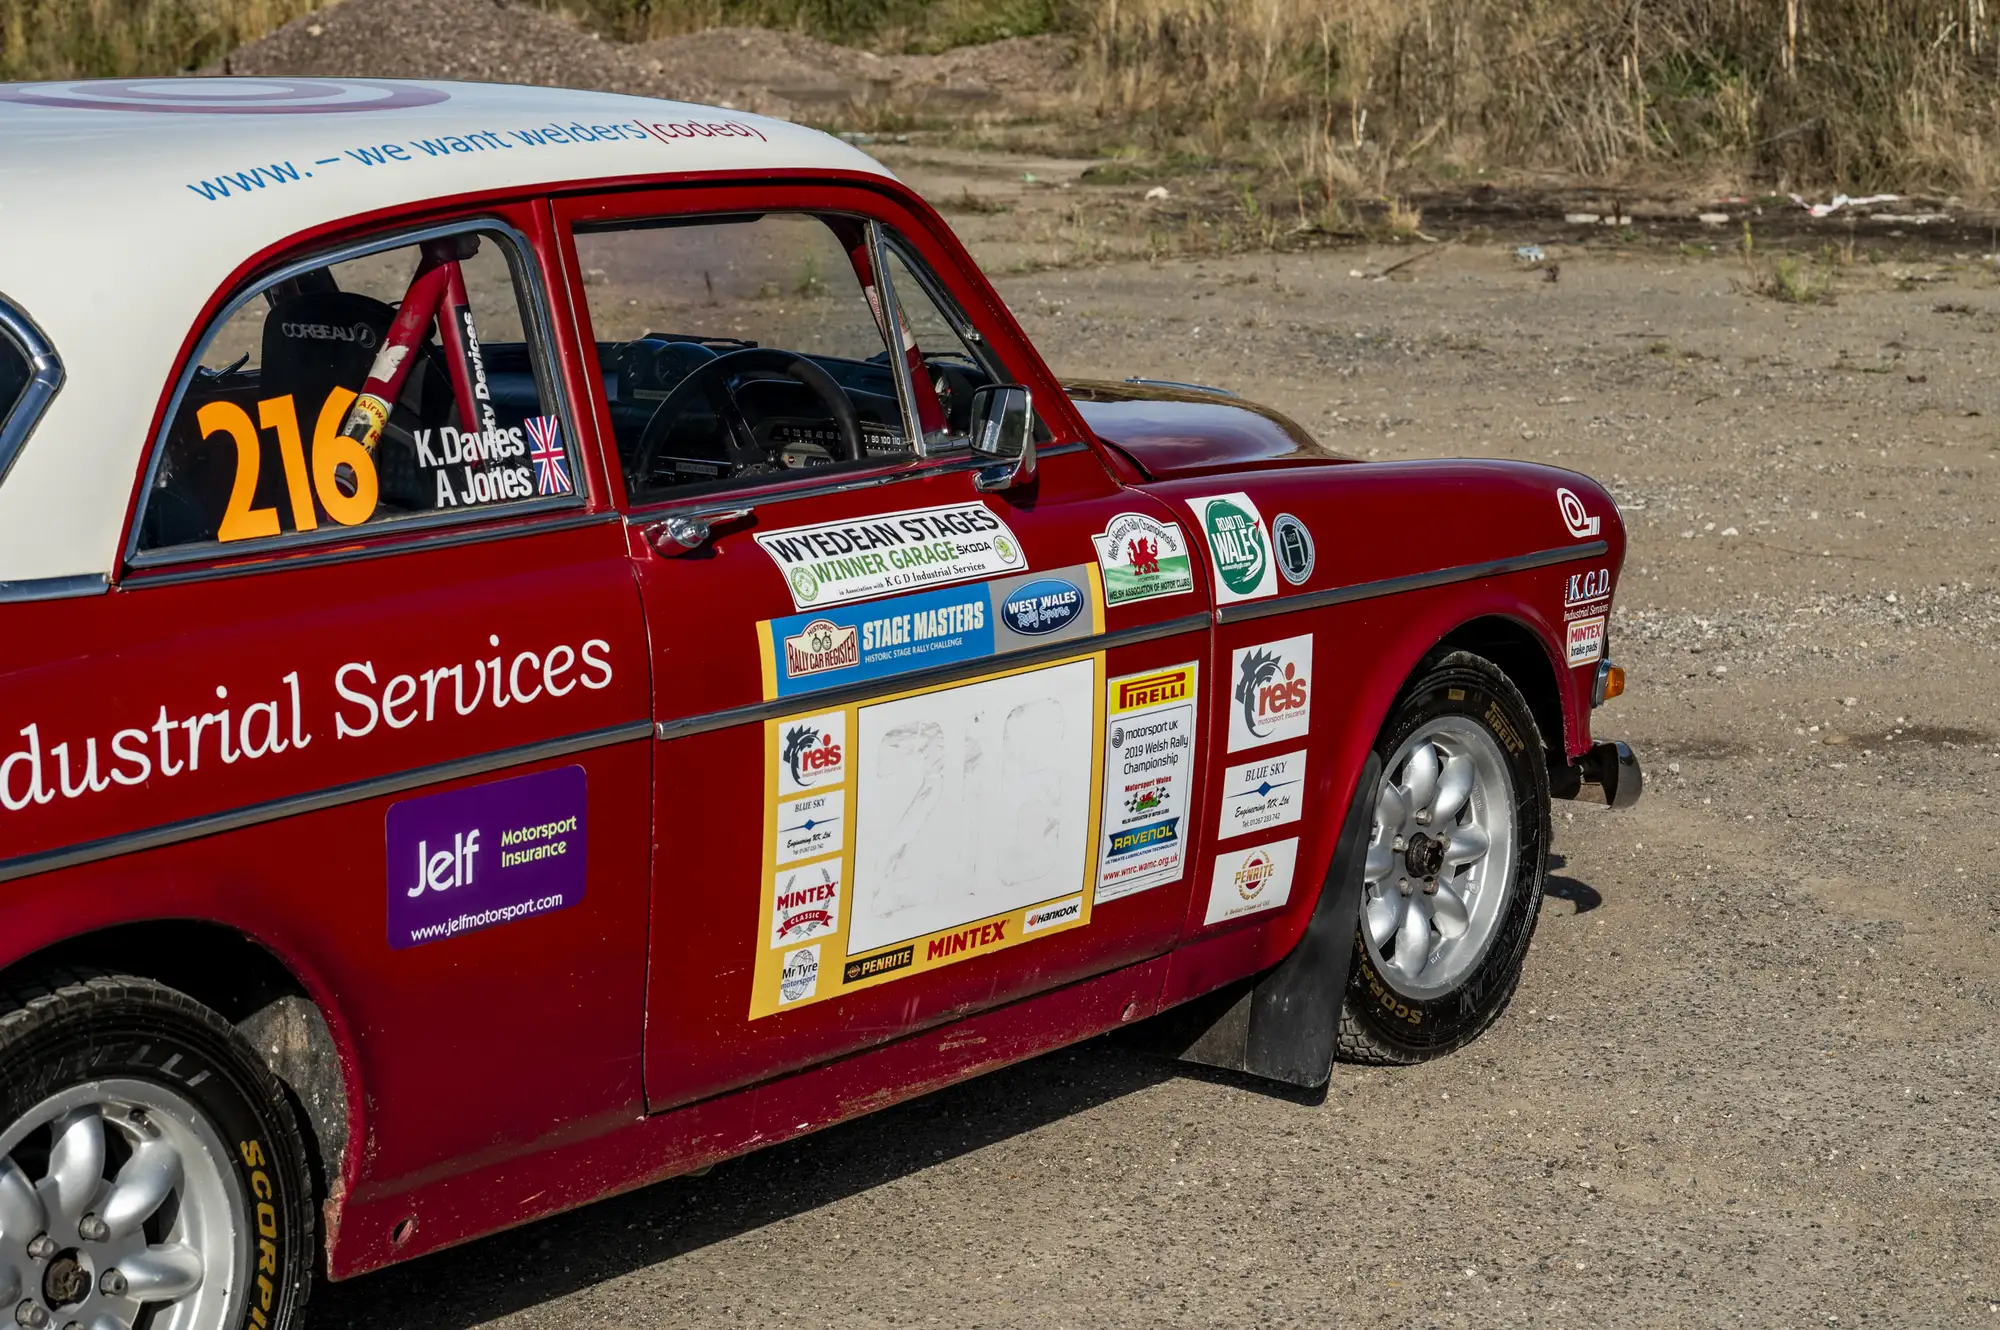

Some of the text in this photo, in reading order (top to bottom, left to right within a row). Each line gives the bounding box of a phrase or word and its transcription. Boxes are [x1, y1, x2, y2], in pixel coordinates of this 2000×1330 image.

[344, 143, 412, 166] we
[409, 129, 512, 157] want
[281, 322, 355, 342] CORBEAU
[464, 312, 490, 400] Devices
[881, 436, 891, 445] 100
[892, 436, 901, 445] 110
[196, 385, 379, 543] 216
[437, 466, 533, 508] A Jones
[1215, 514, 1245, 532] ROAD TO
[766, 509, 999, 563] WYEDEAN STAGES
[1108, 518, 1178, 561] Welsh Historic Rally Championship
[1211, 527, 1263, 566] WALES
[810, 553, 888, 584] WINNER
[889, 540, 958, 570] GARAGE
[845, 586, 872, 595] Association
[885, 576, 894, 587] K
[895, 574, 902, 585] G
[903, 573, 911, 583] D
[912, 566, 952, 582] Industrial
[953, 562, 986, 575] Services
[1109, 578, 1190, 600] WELSH ASSOCIATION OF MOTOR CLUBS
[1008, 591, 1077, 614] WEST WALES
[1039, 605, 1071, 622] Spares
[1563, 602, 1609, 622] Industrial Services
[807, 624, 833, 637] HISTORIC
[862, 601, 984, 650] STAGE MASTERS
[1570, 624, 1601, 643] MINTEX
[788, 630, 857, 674] RALLY CAR REGISTER
[865, 637, 963, 664] HISTORIC STAGE RALLY CHALLENGE
[1571, 641, 1598, 657] brake pads
[335, 635, 613, 740] Services
[1119, 671, 1186, 710] PIRELLI
[1259, 662, 1307, 717] reis
[1257, 708, 1306, 726] motorsport insurance
[1125, 721, 1168, 741] motorsport
[802, 733, 842, 772] reis
[1124, 735, 1189, 760] 2019 Welsh Rally
[1123, 752, 1179, 775] Championship
[1245, 761, 1287, 782] BLUE SKY
[1124, 775, 1172, 793] Motorsport Wales
[794, 798, 826, 812] BLUE SKY
[1234, 804, 1266, 818] Engineering
[1278, 795, 1291, 806] Ltd
[501, 816, 577, 848] Motorsport
[1113, 826, 1173, 851] RAVENOL
[407, 830, 480, 897] Jelf
[501, 840, 566, 868] Insurance
[1125, 848, 1152, 861] LUBRICATION
[1103, 853, 1179, 881] www.wnrc.wamc.org.uk
[1234, 863, 1275, 885] PENRITE
[776, 882, 836, 911] MINTEX
[411, 892, 563, 941] www.jelfmotorsport.com
[790, 911, 820, 925] CLASSIC
[926, 919, 1007, 961] MINTEX
[782, 961, 818, 980] Mr Tyre
[861, 950, 911, 975] PENRITE
[780, 974, 816, 989] motorsport
